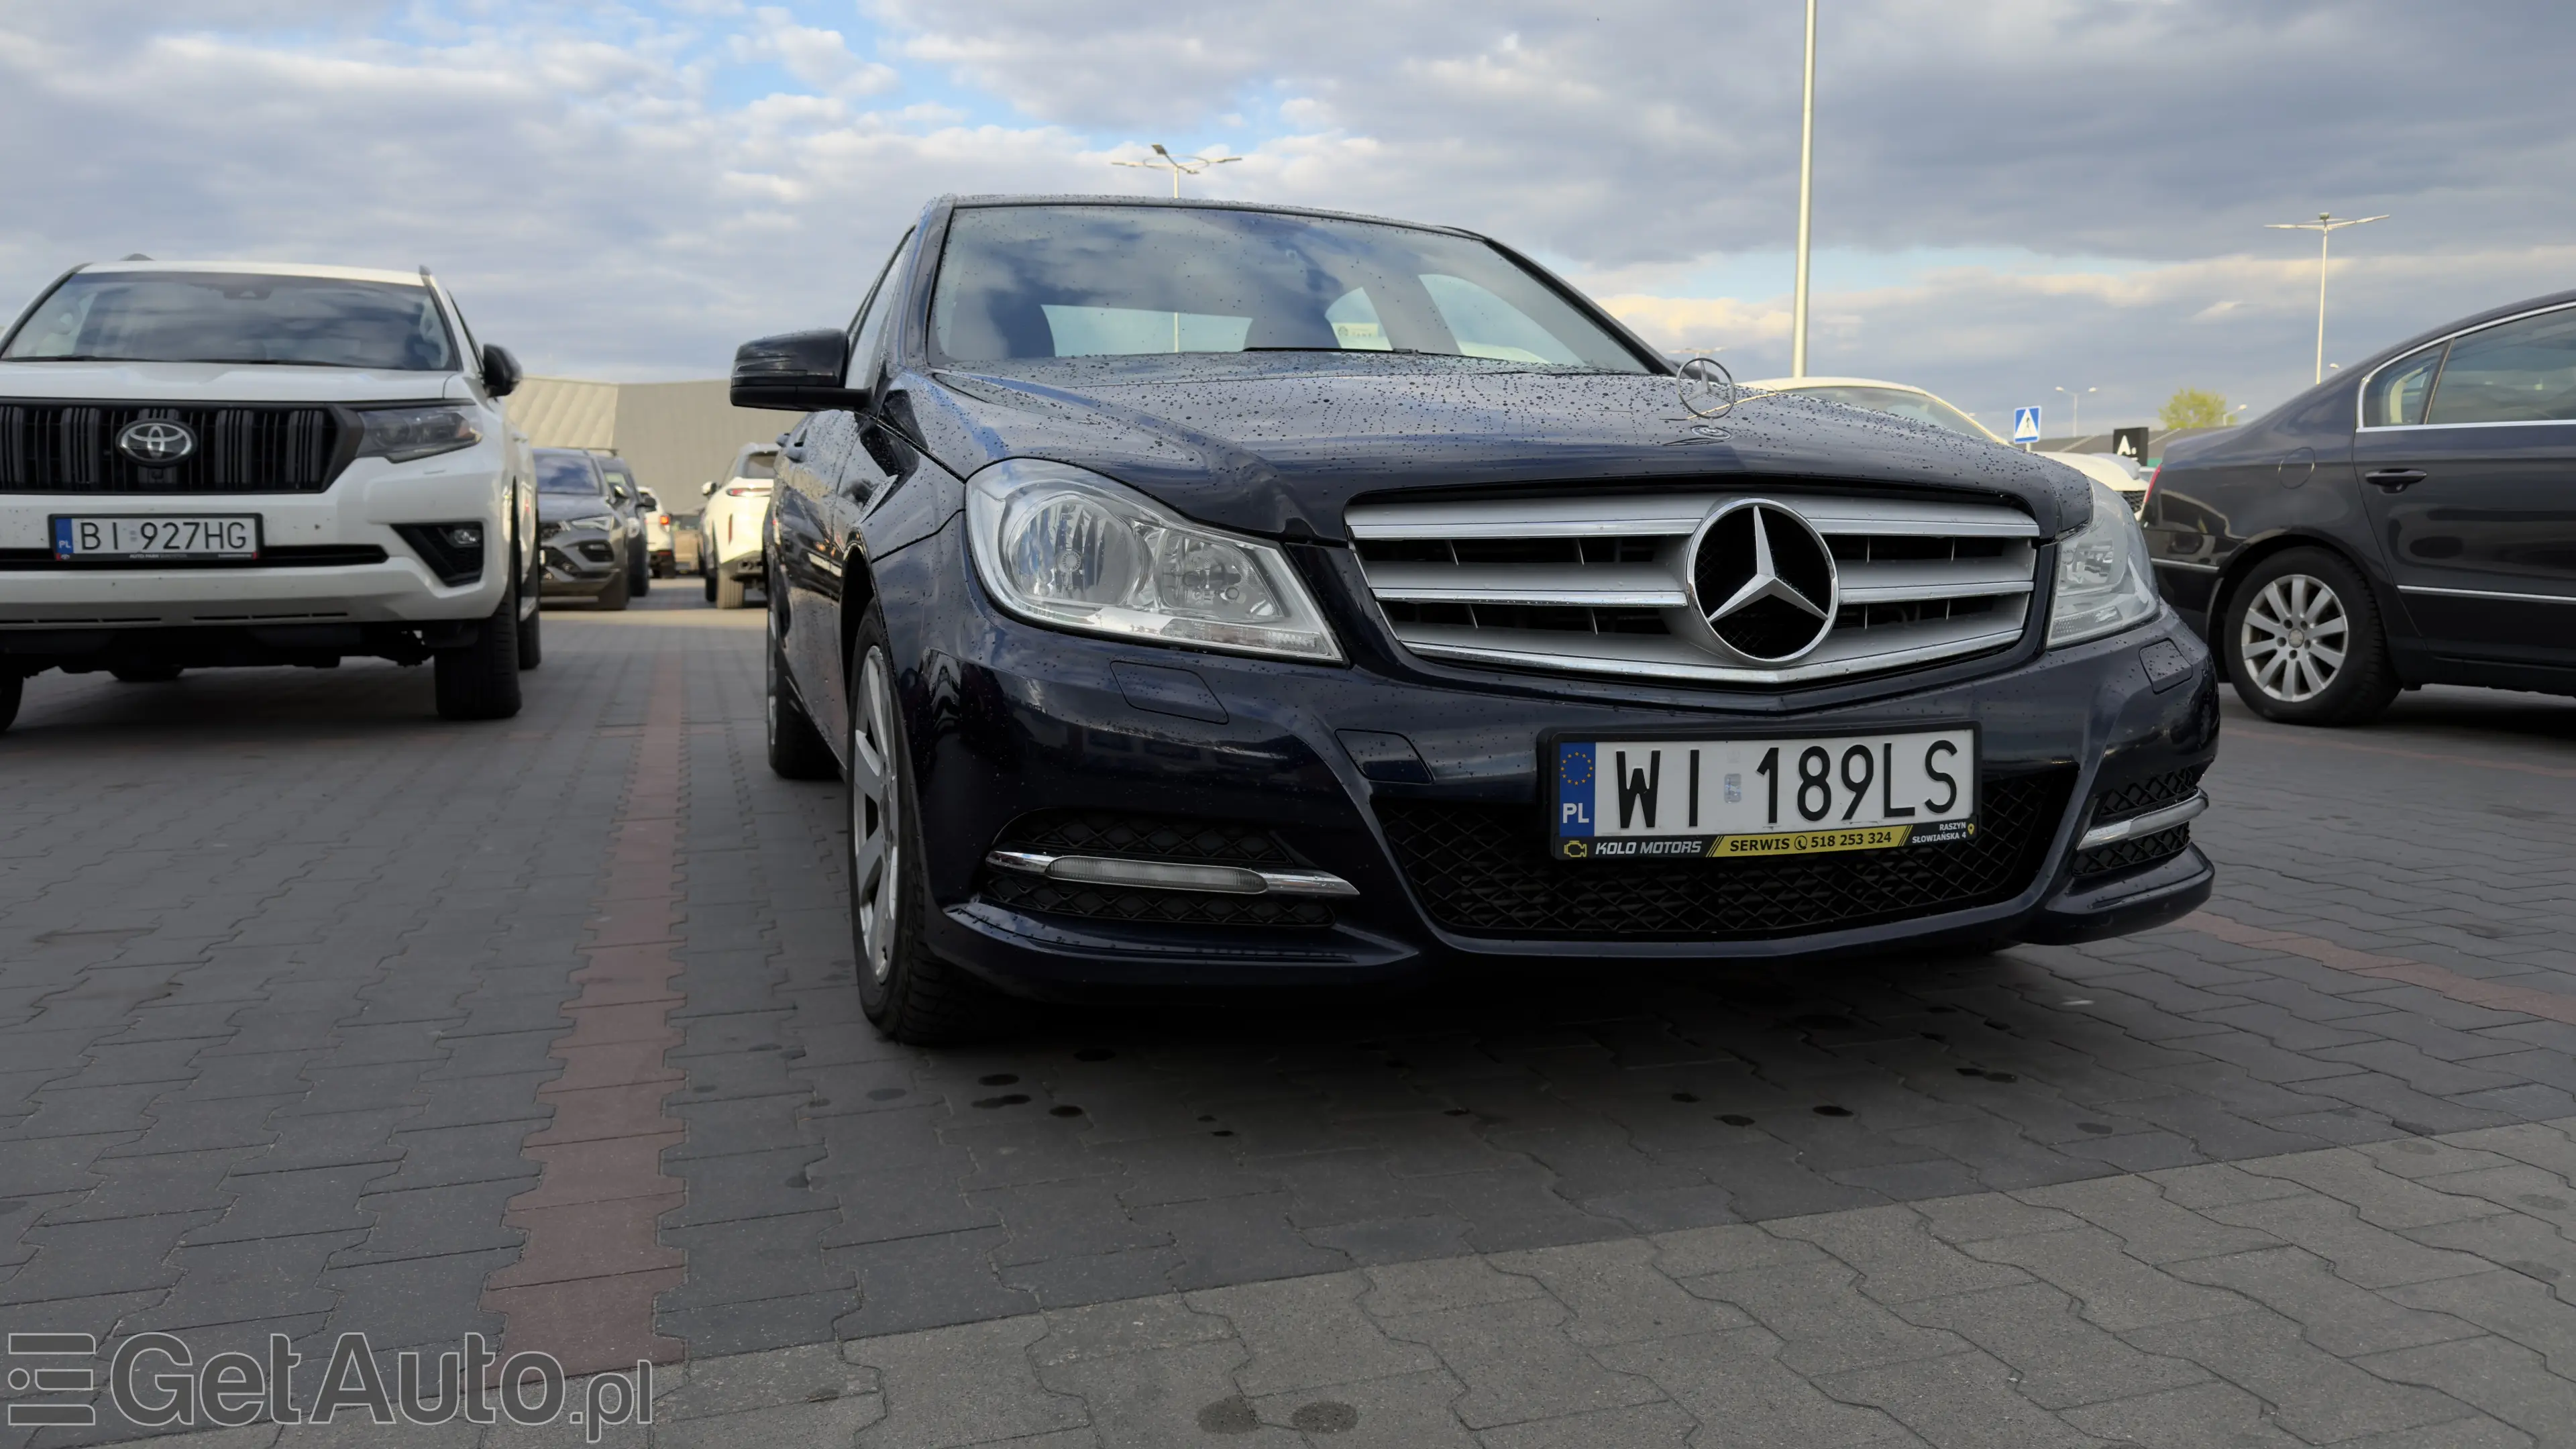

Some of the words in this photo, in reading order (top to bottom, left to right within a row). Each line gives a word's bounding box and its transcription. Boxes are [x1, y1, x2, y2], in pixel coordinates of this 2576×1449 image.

[80, 522, 118, 550] BI
[140, 521, 246, 550] 927HG
[58, 540, 71, 549] PL
[1616, 749, 1699, 828] WI
[1755, 739, 1958, 824] 189LS
[1562, 802, 1590, 824] PL
[1939, 822, 1966, 831] RASZYN
[1729, 837, 1790, 852] SERWIS
[1811, 835, 1835, 848] 518
[1839, 833, 1864, 846] 253
[1868, 831, 1892, 844] 324
[1912, 833, 1960, 844] SŁOWIAŃSKA
[1595, 842, 1637, 855] KOLO
[1640, 841, 1703, 854] MOTORS
